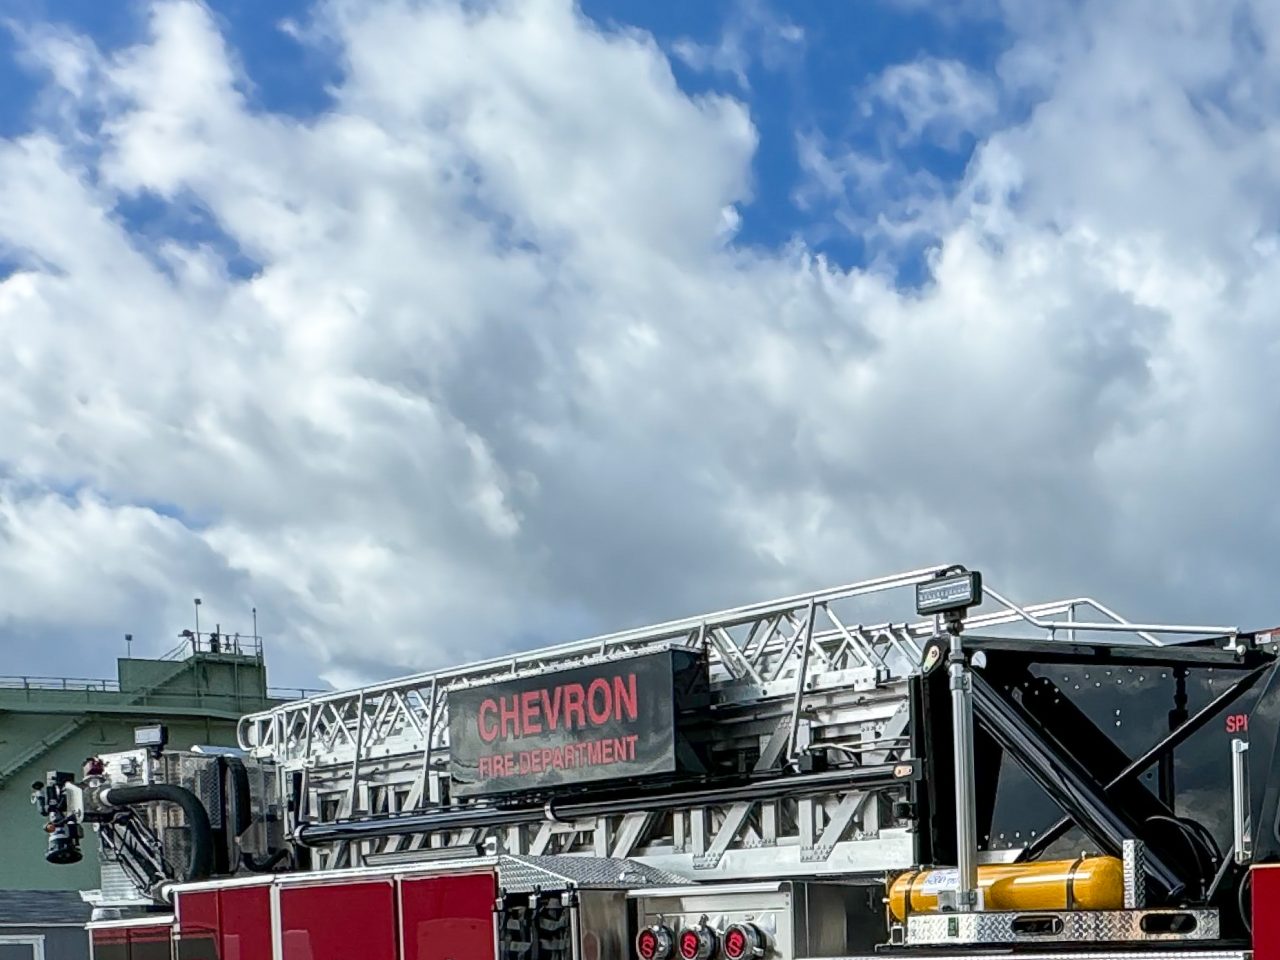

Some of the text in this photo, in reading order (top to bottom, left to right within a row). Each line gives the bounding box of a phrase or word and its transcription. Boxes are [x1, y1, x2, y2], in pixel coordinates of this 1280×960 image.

[478, 673, 638, 742] CHEVRON
[479, 734, 638, 779] FIRE DEPARTMENT
